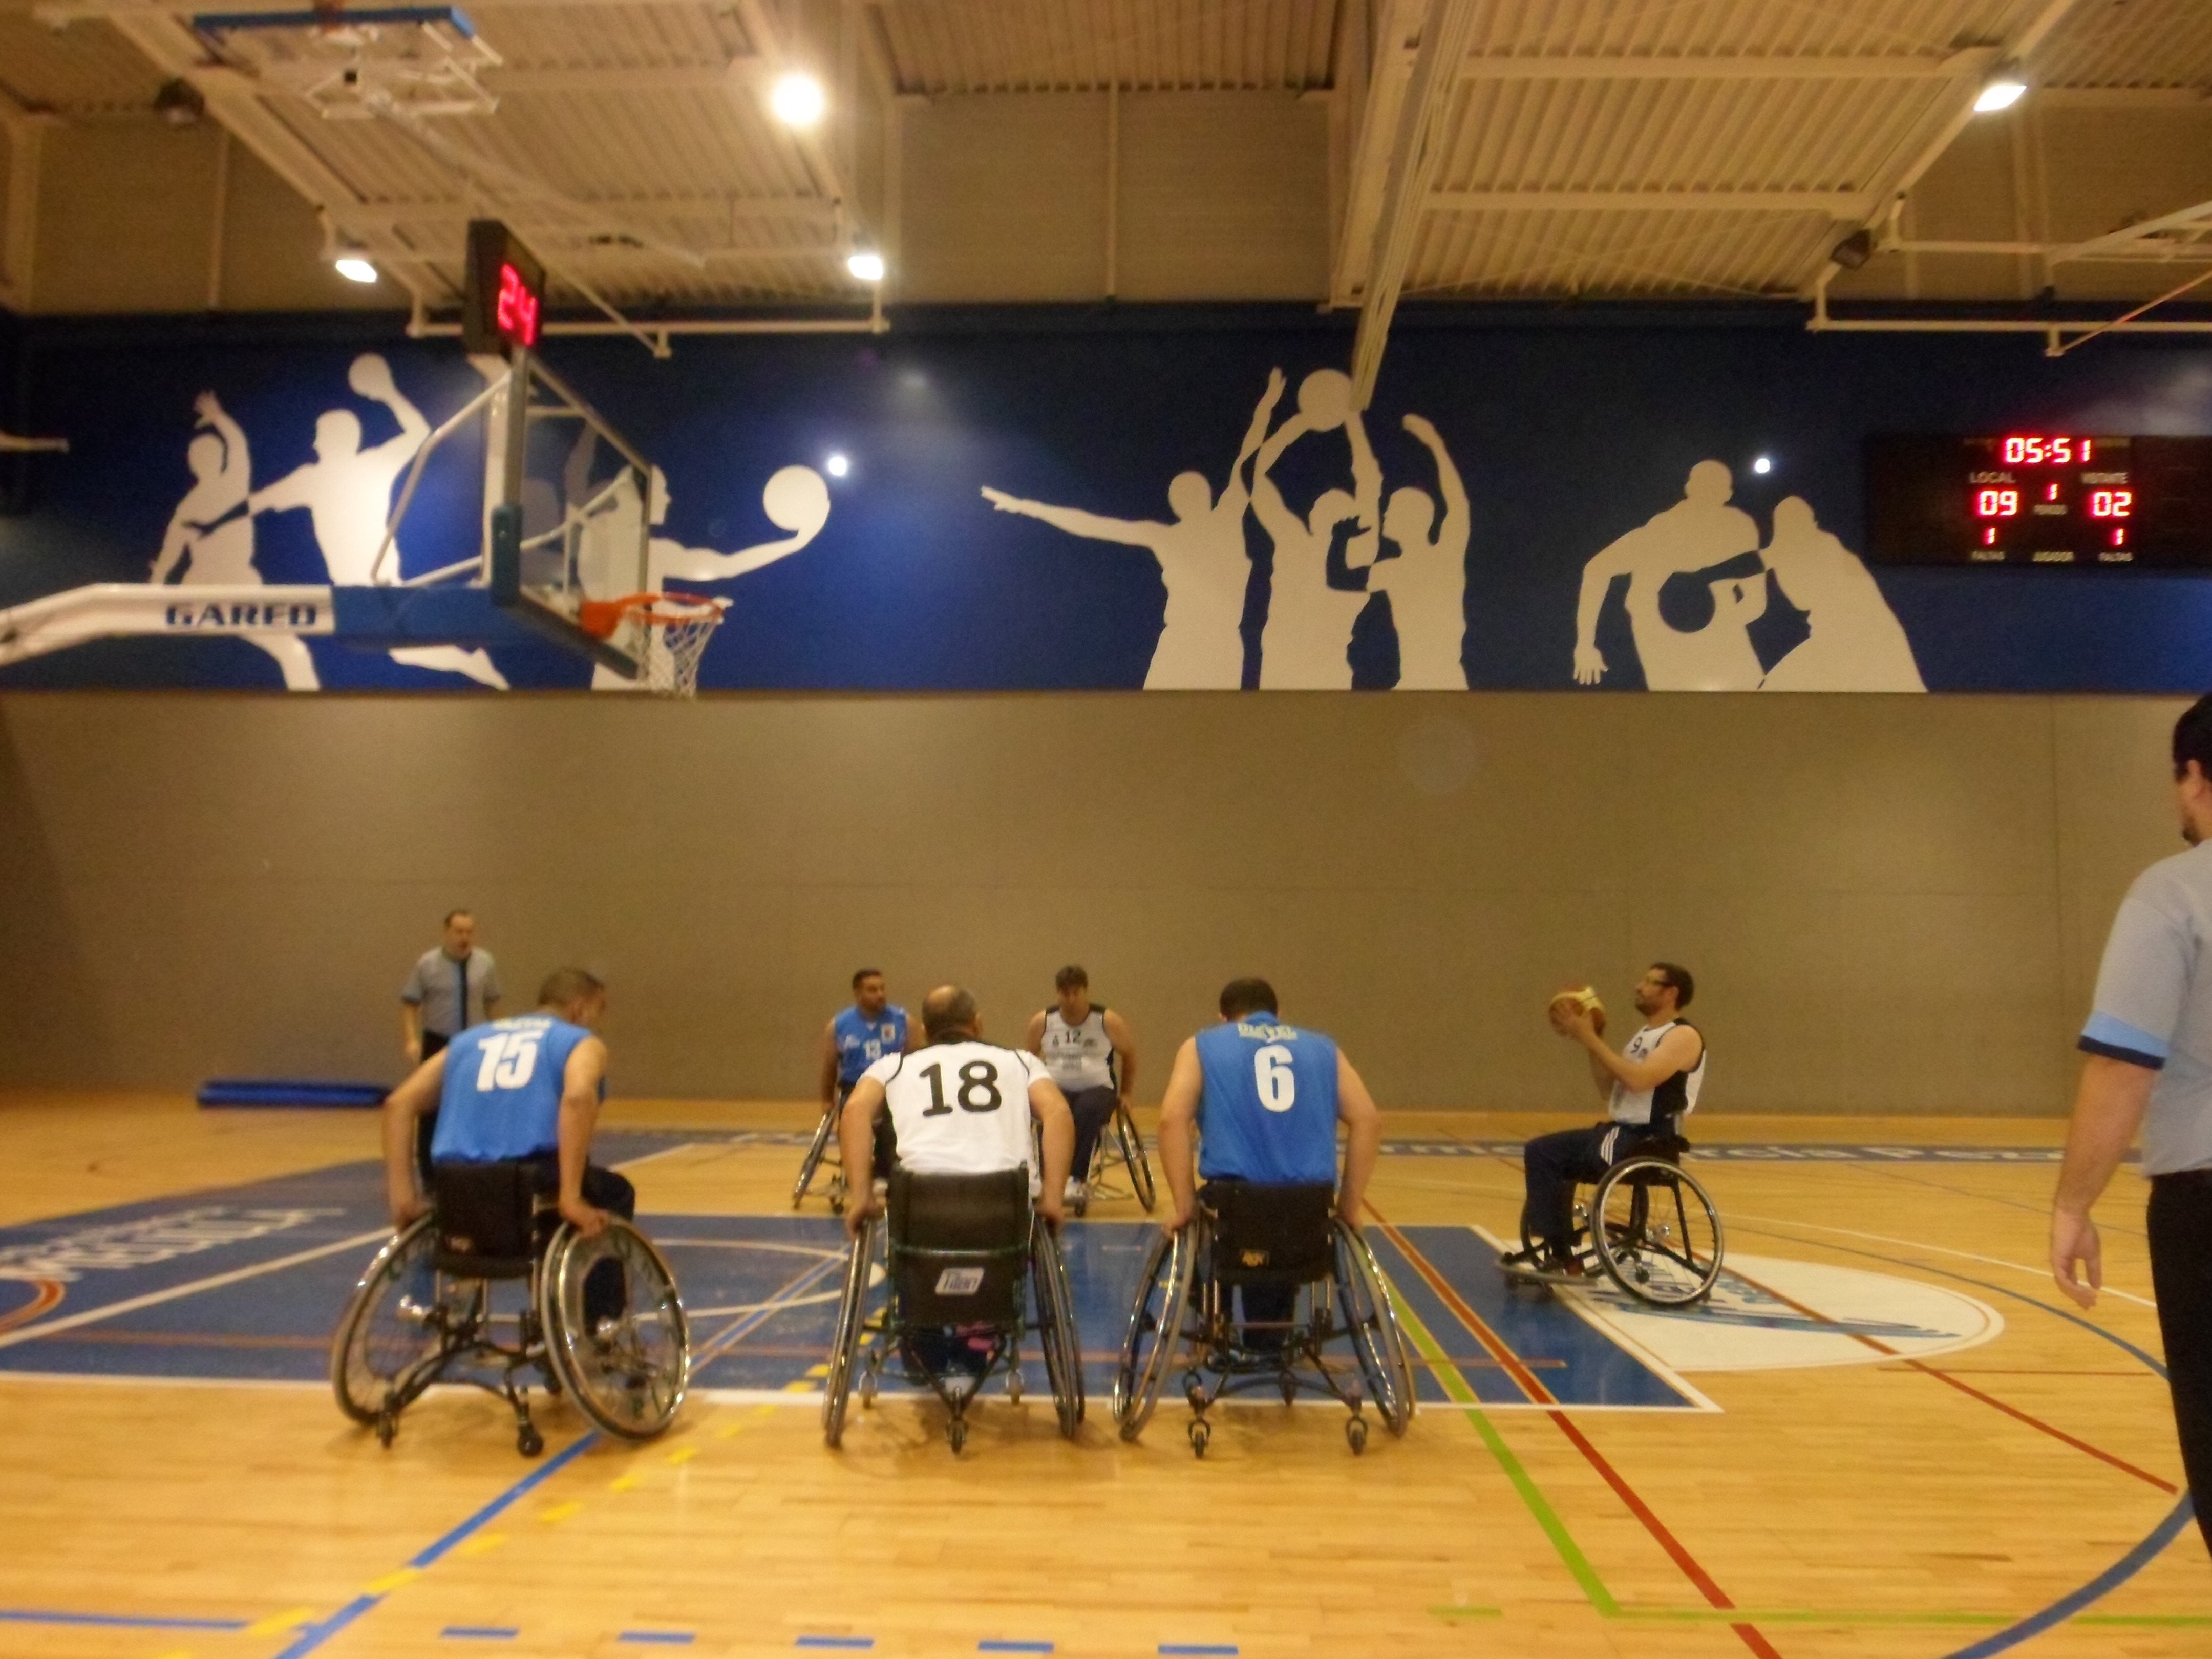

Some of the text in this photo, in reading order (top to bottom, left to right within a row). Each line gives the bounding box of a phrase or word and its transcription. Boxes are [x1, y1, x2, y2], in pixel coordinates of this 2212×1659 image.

[498, 264, 537, 346] 24
[2006, 438, 2091, 463] 05:51
[1969, 471, 2016, 484] LOCAL
[1980, 490, 2018, 515] 09
[2050, 484, 2058, 500] 1
[2093, 491, 2132, 516] 02
[1987, 528, 1996, 544] 1
[2115, 529, 2124, 545] 1
[476, 1030, 545, 1092] 15
[919, 1060, 1002, 1117] 18
[1254, 1044, 1295, 1112] 6
